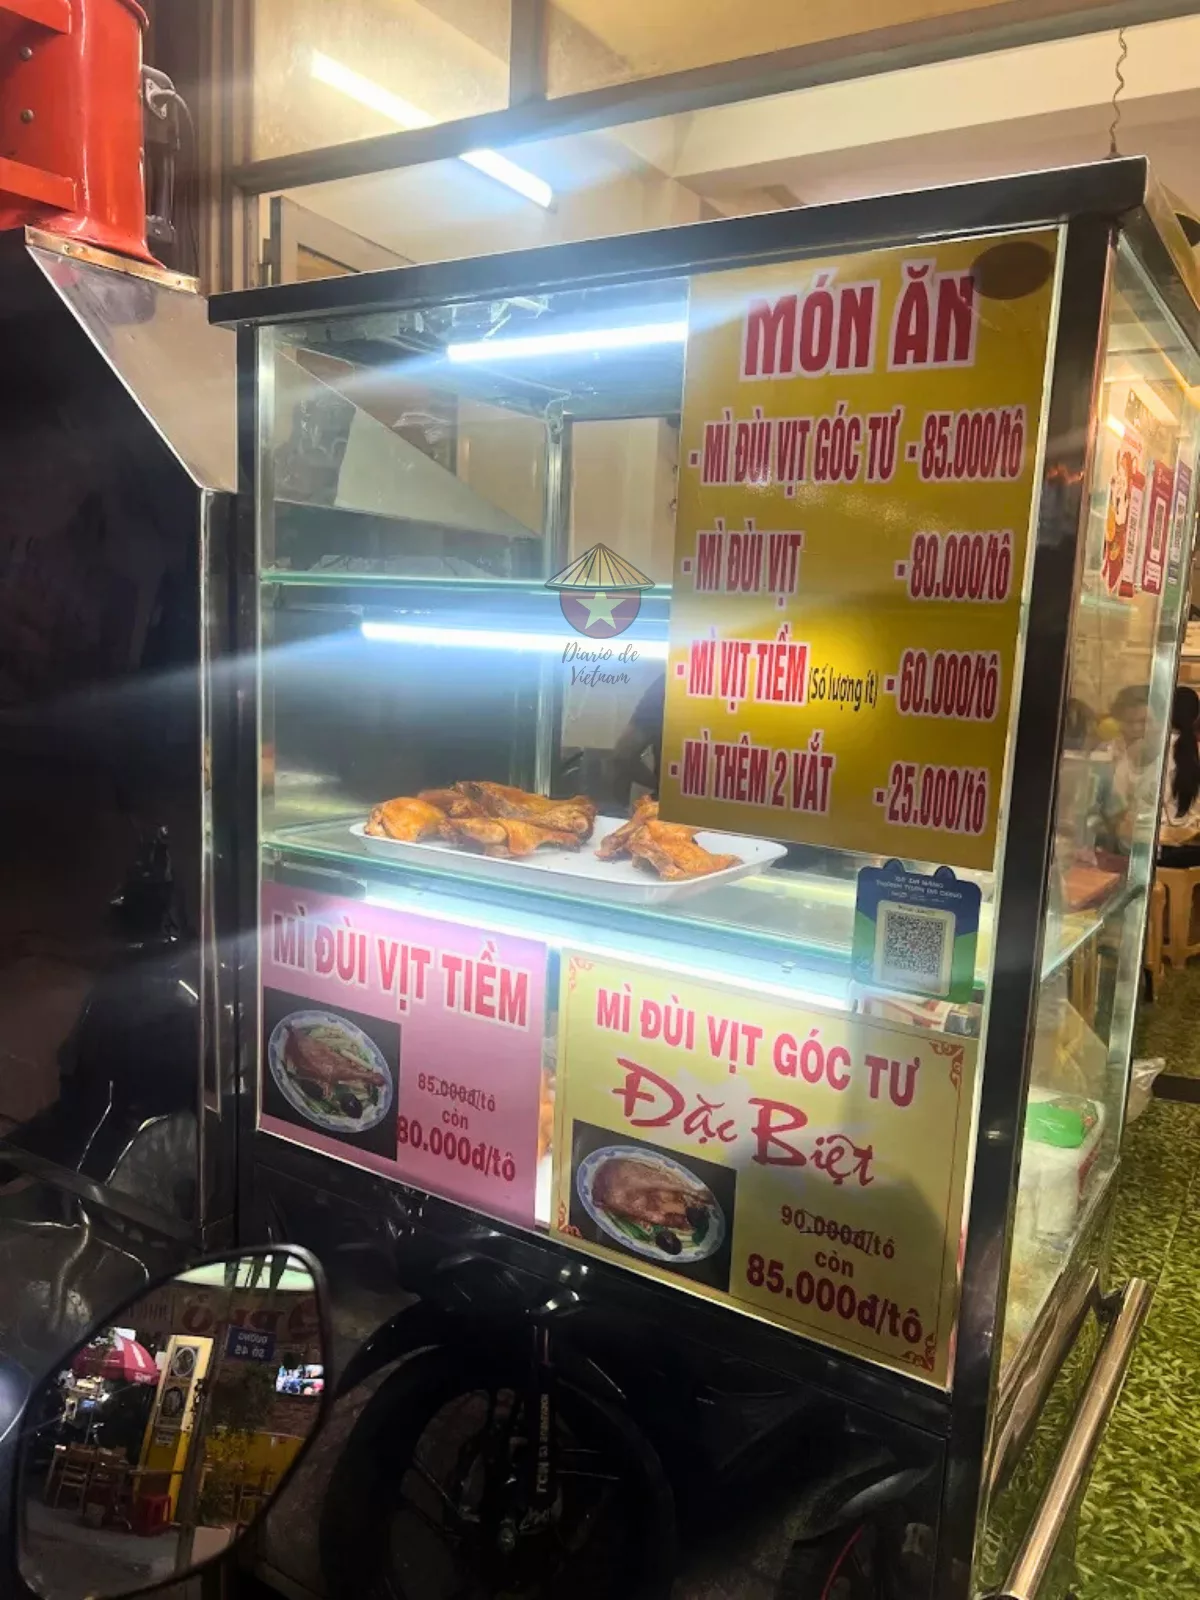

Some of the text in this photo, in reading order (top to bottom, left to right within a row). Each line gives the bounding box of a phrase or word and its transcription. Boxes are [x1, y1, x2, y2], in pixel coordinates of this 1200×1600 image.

[744, 265, 974, 376] MÓN ĂN
[735, 408, 771, 482] ĐÙI
[777, 420, 810, 495] VỊT
[814, 404, 860, 481] GÓC
[868, 408, 900, 479] TƯ
[727, 520, 762, 591] ĐÙI
[768, 534, 801, 606] VỊT
[721, 642, 751, 709] VỊT
[756, 624, 806, 702] TIỀM
[808, 663, 825, 702] (Số
[828, 667, 861, 711] lượng
[865, 669, 877, 708] ít)
[715, 735, 769, 804] THÊM
[772, 752, 786, 806] 2
[793, 732, 833, 811] VẮT
[274, 905, 528, 1027] MÌ ĐÙI VỊT TIỀM
[597, 984, 920, 1107] MÌ ĐÙI VỊT GÓC TƯ
[397, 1115, 516, 1181] 80.000đ/tô
[442, 1108, 468, 1130] còn
[611, 1057, 875, 1186] Đặc Biệt
[781, 1204, 897, 1260] 90.000đ/tô
[815, 1250, 854, 1278] còn
[747, 1253, 922, 1343] 85.000đ/tô
